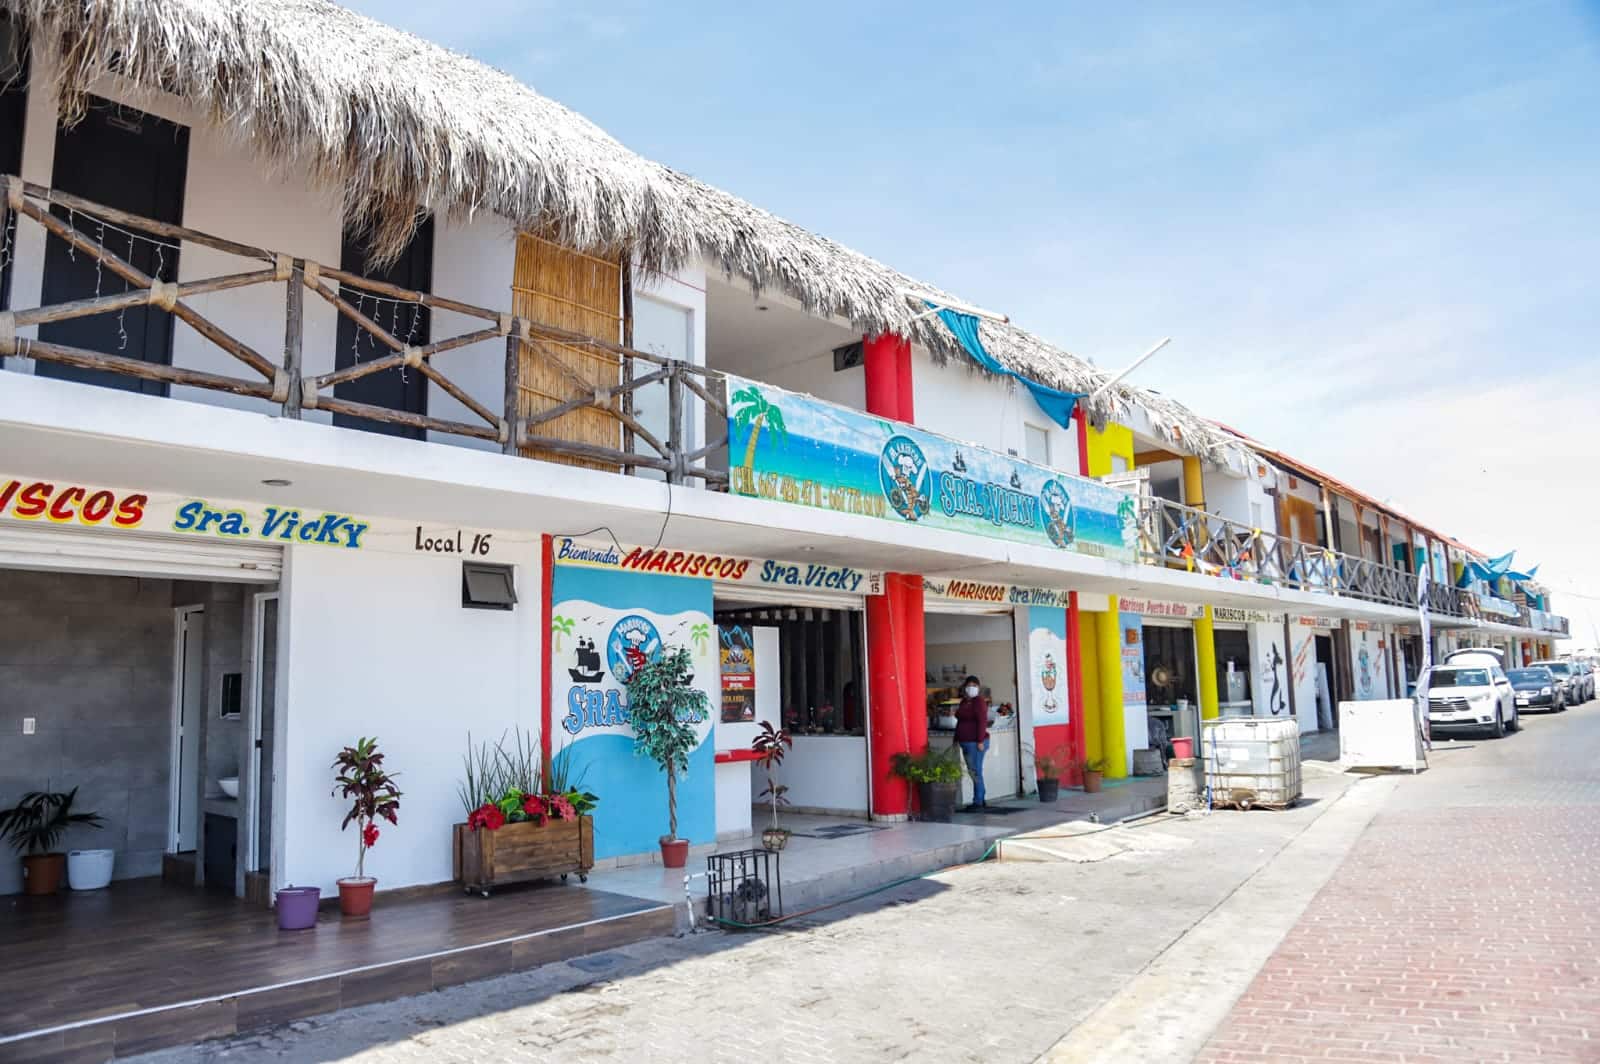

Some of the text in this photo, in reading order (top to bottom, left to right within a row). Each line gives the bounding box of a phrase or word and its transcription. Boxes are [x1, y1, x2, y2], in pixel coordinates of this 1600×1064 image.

[940, 471, 984, 517] SRA.
[985, 482, 1036, 528] VICKY
[174, 501, 250, 535] Sra.
[415, 526, 491, 555] Local 16
[621, 546, 750, 580] MARISCOS
[871, 583, 880, 592] 15
[946, 580, 1006, 602] MARISCOS
[1214, 607, 1246, 621] MARISCOS
